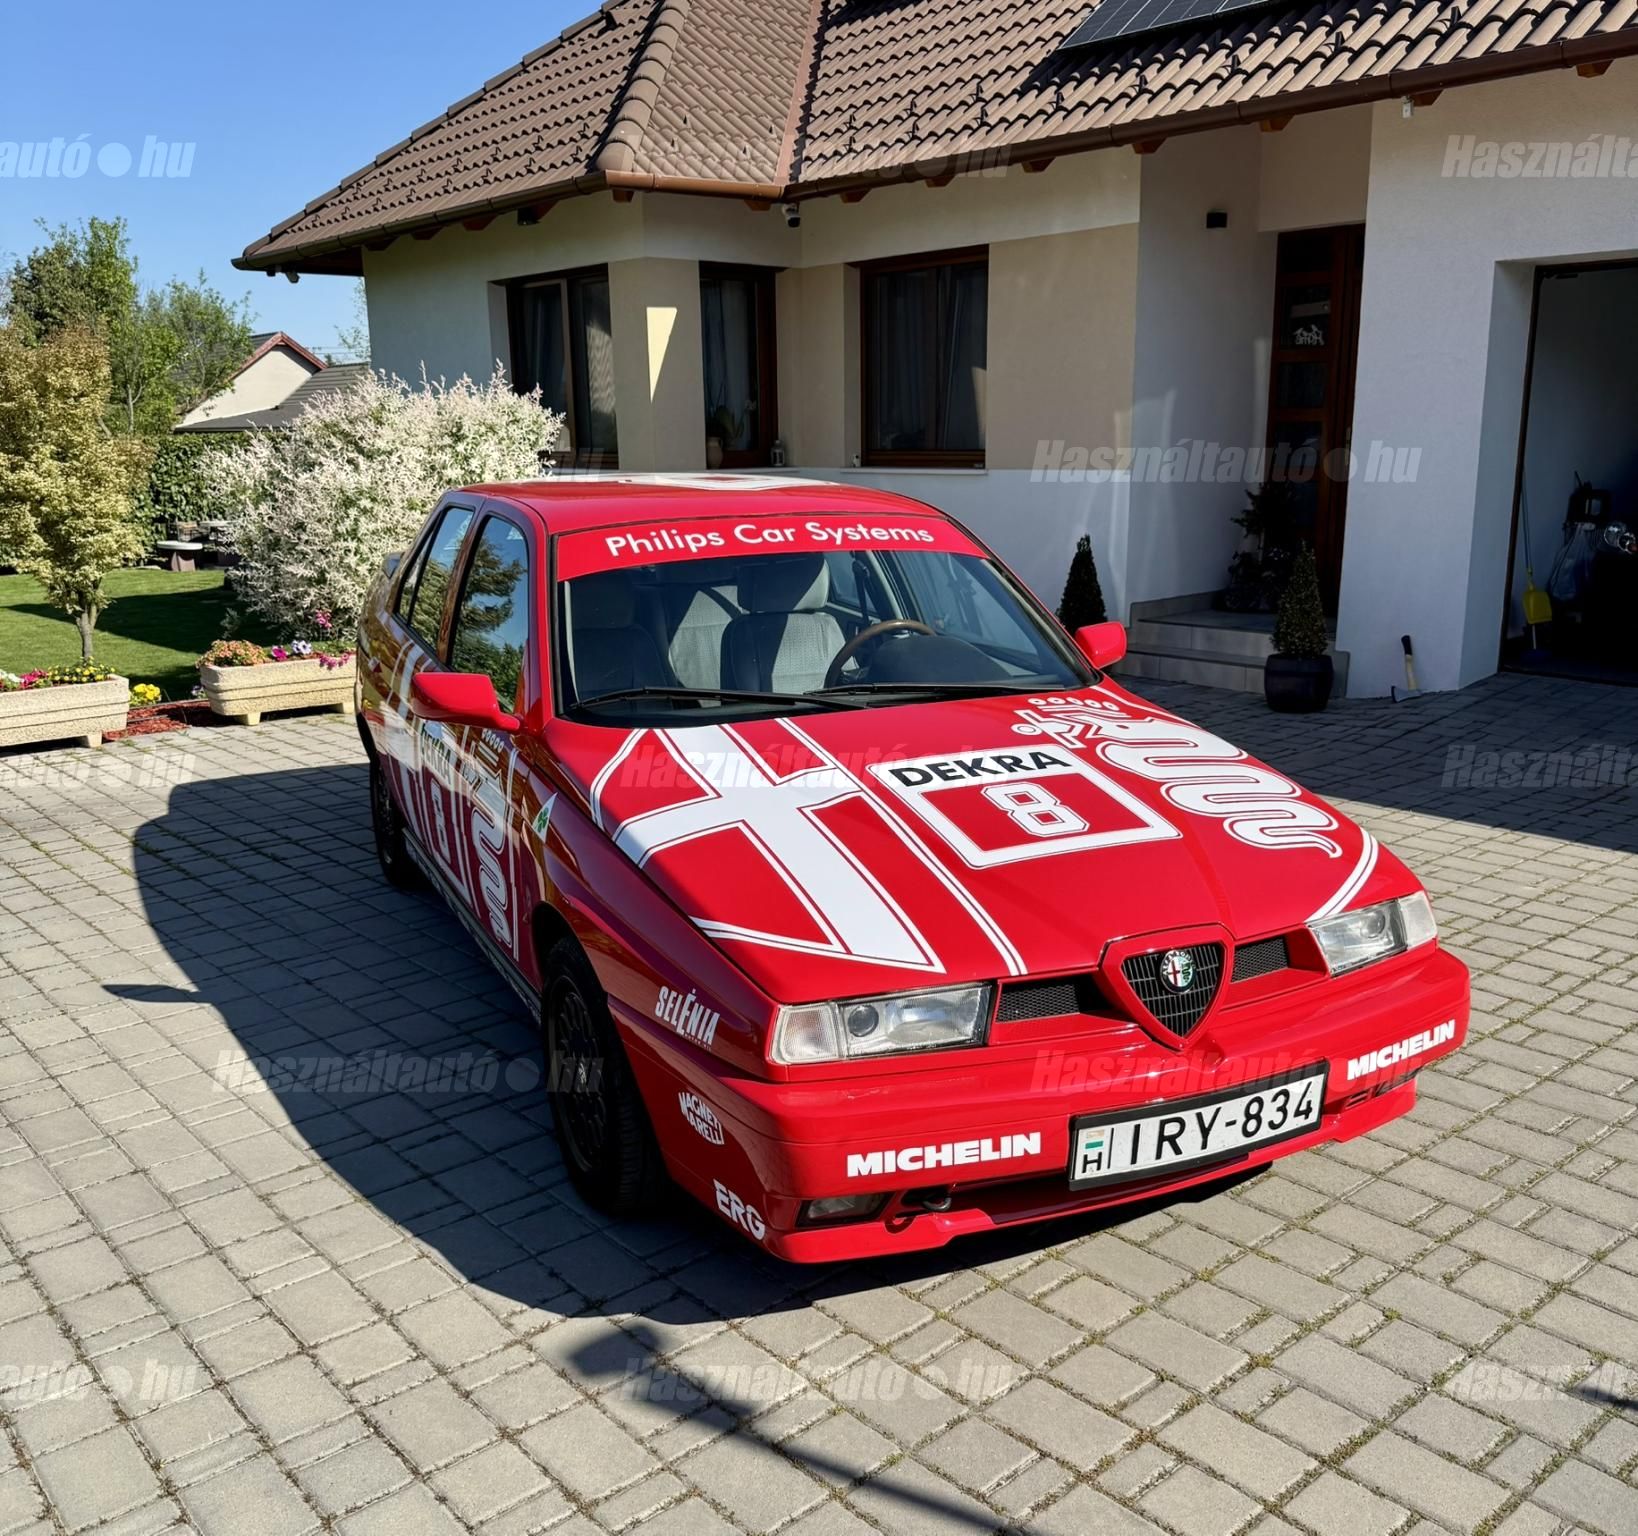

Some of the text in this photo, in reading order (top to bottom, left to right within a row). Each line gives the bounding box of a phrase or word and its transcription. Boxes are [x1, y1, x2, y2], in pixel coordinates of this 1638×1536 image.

[604, 521, 935, 557] Philips Car Systems
[889, 751, 1072, 788] DEKRA
[981, 782, 1090, 837] 8
[1347, 1019, 1456, 1080] MICHELIN
[1130, 1080, 1314, 1165] IRY-834
[847, 1131, 1041, 1177] MICHELIN
[713, 1178, 766, 1240] ERG
